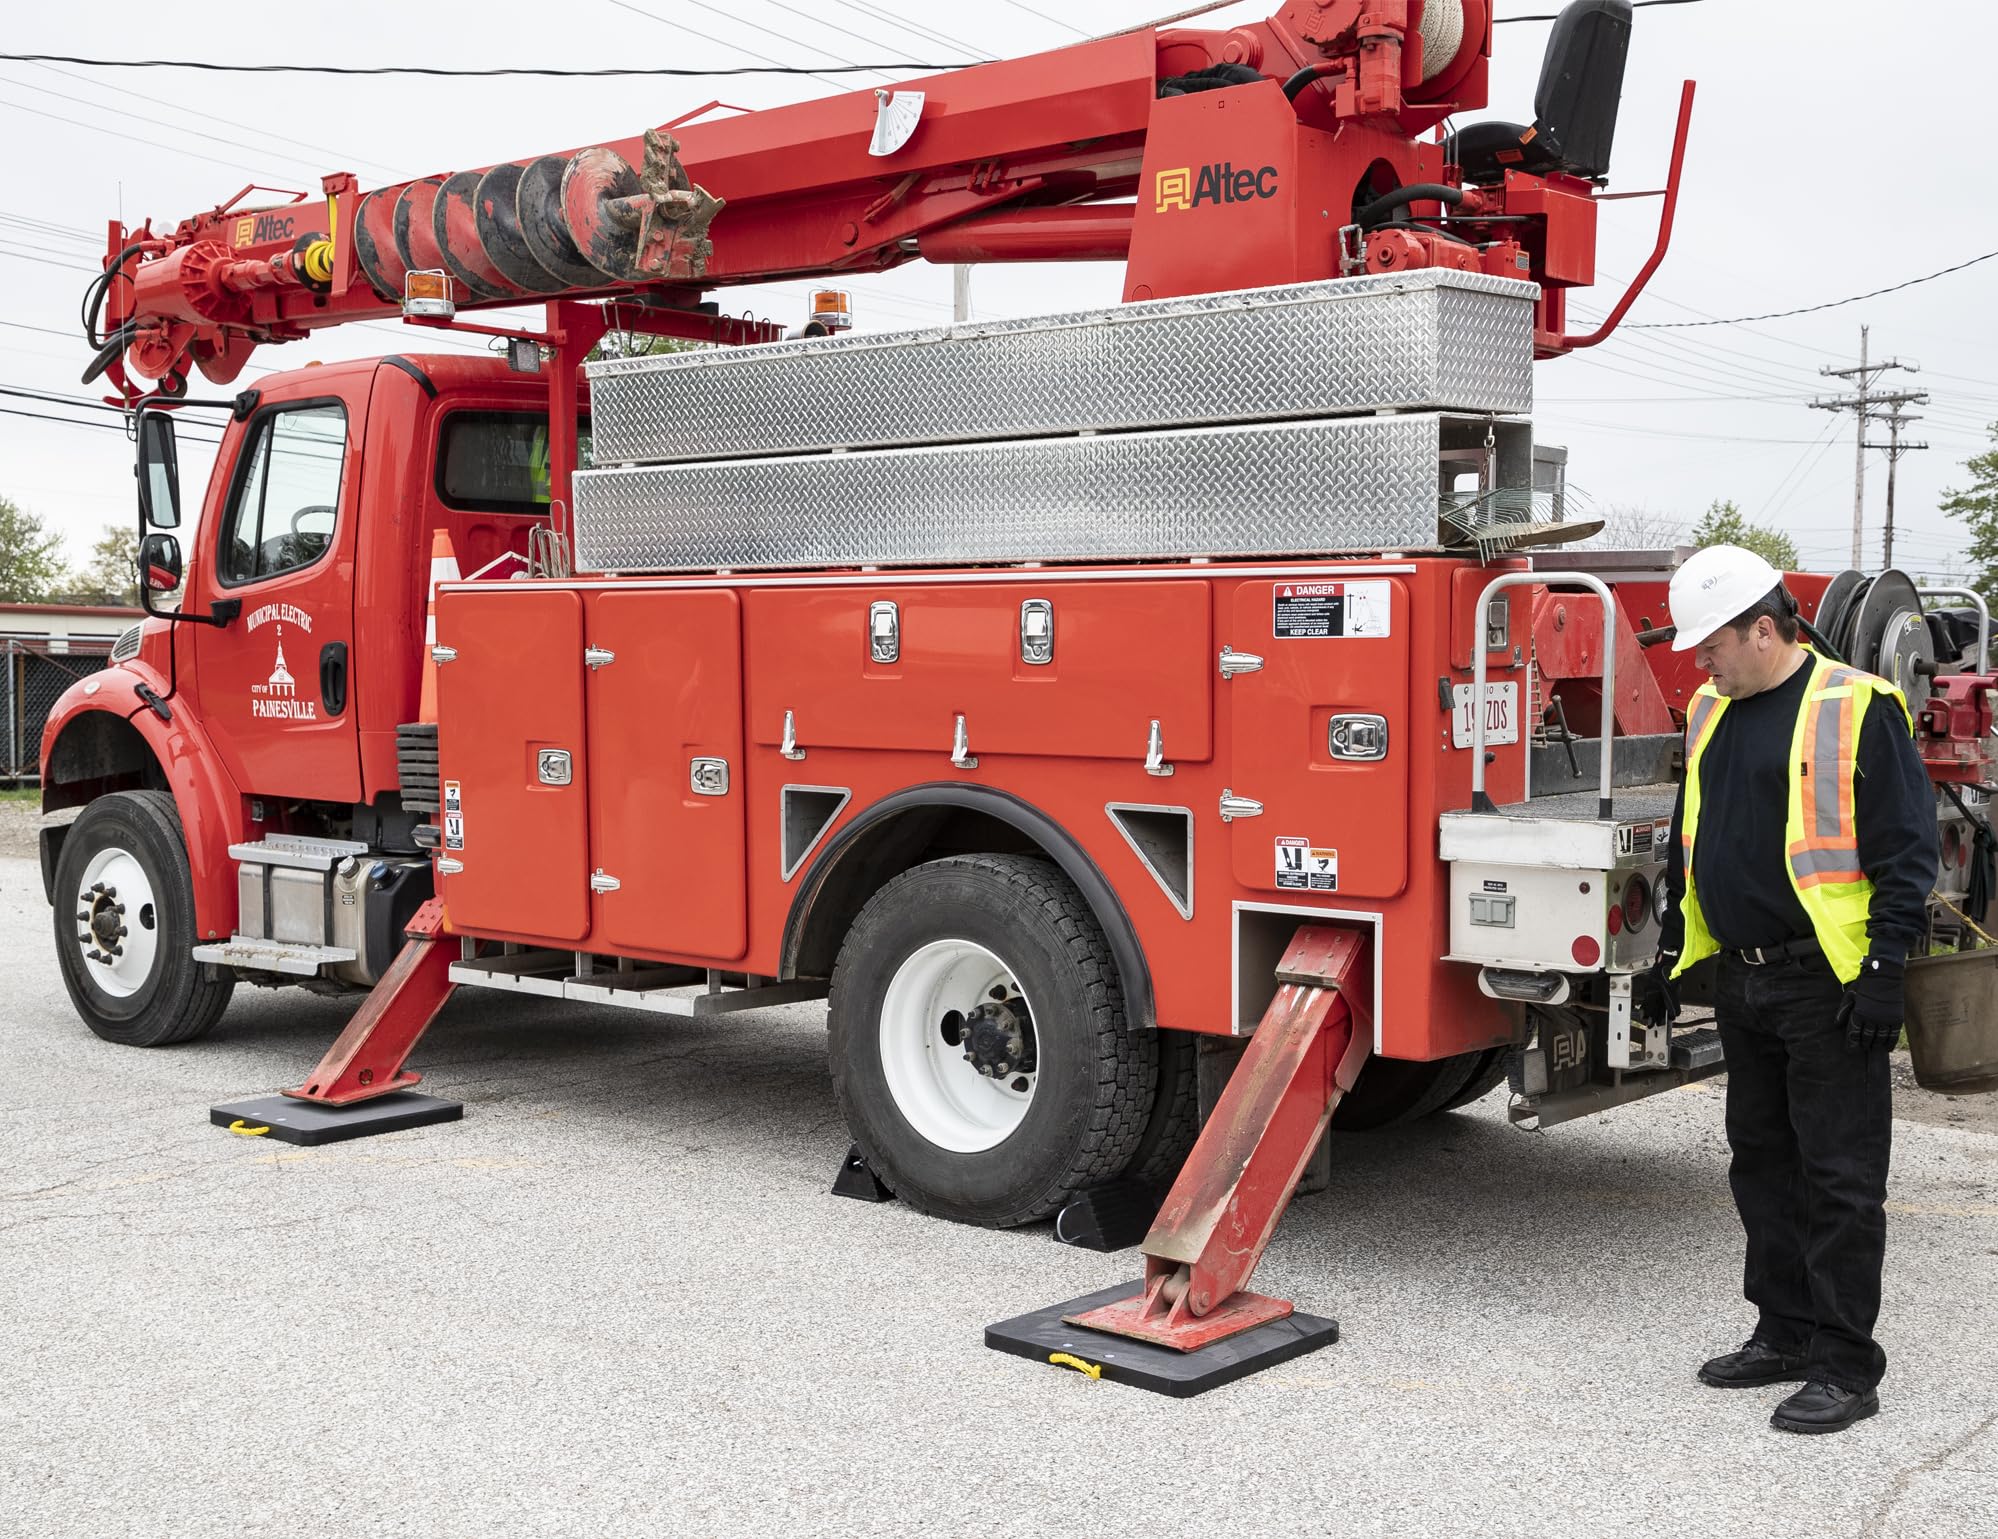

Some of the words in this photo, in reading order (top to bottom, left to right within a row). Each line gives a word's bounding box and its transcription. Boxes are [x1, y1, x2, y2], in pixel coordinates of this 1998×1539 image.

[1191, 162, 1278, 208] Altec
[252, 215, 294, 245] Altec
[1296, 585, 1335, 596] DANGER
[247, 603, 280, 633] MUNICIPAL
[281, 603, 312, 634] ELECTRIC
[276, 624, 282, 636] 2
[1290, 628, 1306, 636] KEEP
[252, 698, 316, 720] PAINESVILLE
